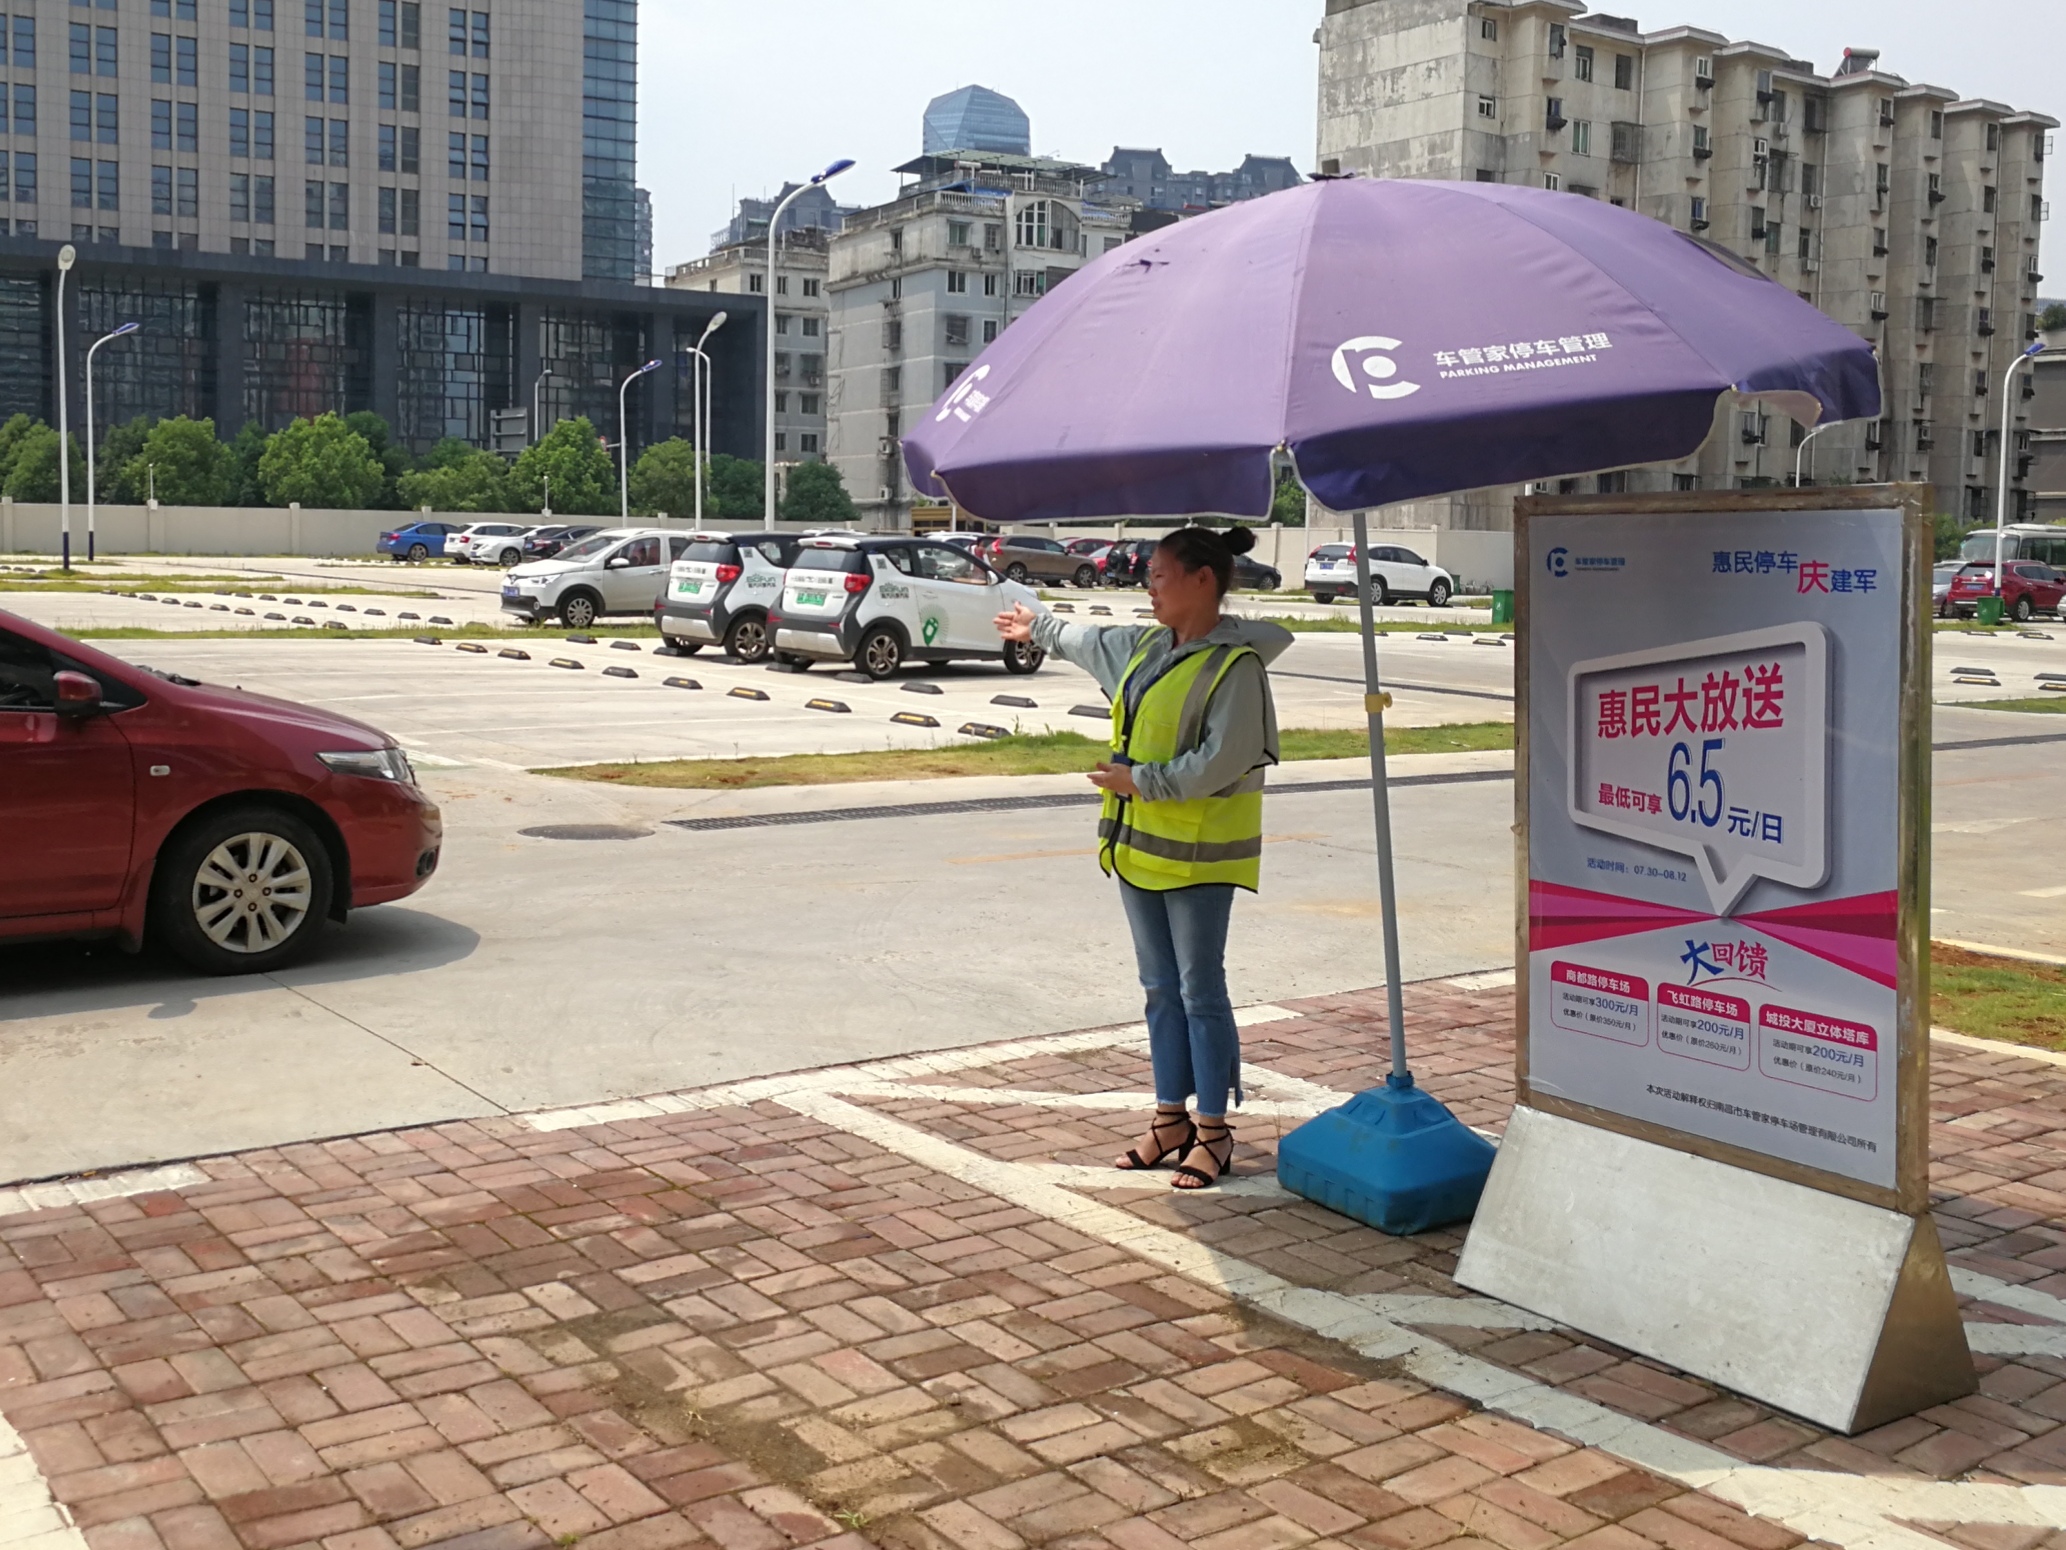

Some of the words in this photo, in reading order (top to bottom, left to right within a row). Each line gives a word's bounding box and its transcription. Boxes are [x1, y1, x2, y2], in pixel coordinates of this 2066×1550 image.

[1433, 332, 1613, 367] 车管家停车管理
[1440, 365, 1500, 379] PARKING
[1503, 354, 1597, 372] MANAGEMENT
[1712, 550, 1877, 594] 惠民停车庆建军
[1598, 662, 1784, 739] 惠民大放送
[1680, 939, 1769, 985] 大回馈
[1667, 990, 1738, 1017] 飞虹路停车场
[1766, 1010, 1870, 1045] 城投大厦立体塔库
